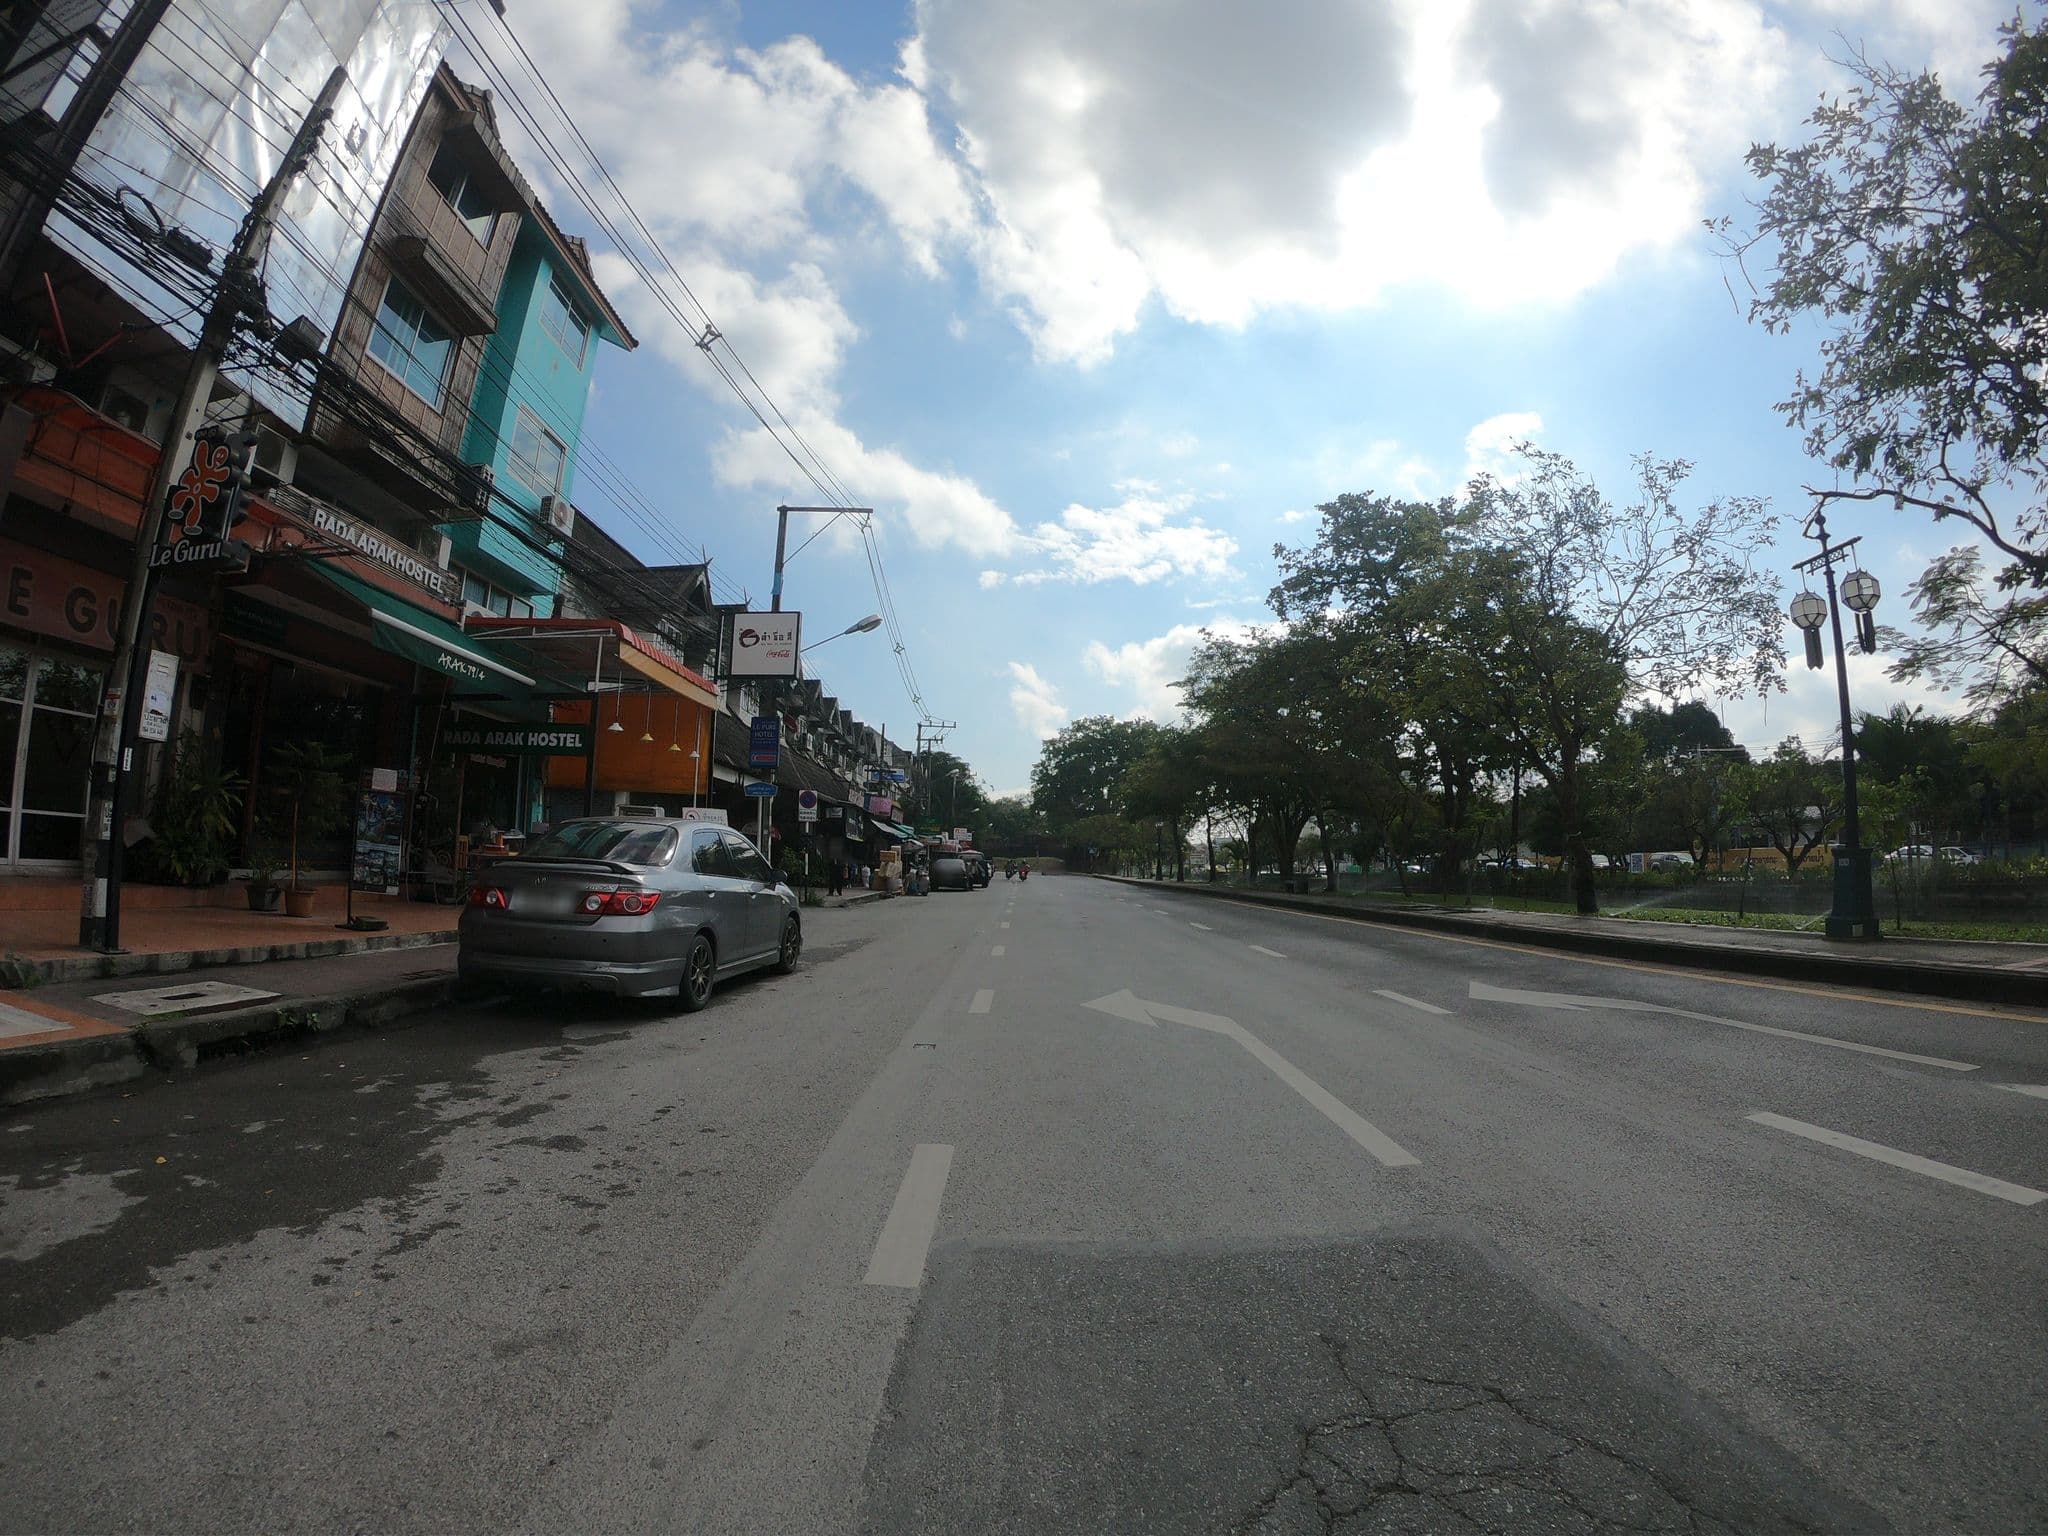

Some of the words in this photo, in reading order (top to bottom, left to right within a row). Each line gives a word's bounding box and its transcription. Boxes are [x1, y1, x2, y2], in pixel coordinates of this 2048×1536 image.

[149, 542, 172, 568] Le
[173, 539, 223, 563] Guru
[314, 508, 356, 544] RADA
[356, 533, 399, 567] ARAK
[396, 552, 444, 594] HOSTEL
[437, 652, 468, 673] ARAK
[443, 729, 482, 745] RADA
[484, 732, 524, 746] ARAK
[528, 732, 583, 748] HOSTEL
